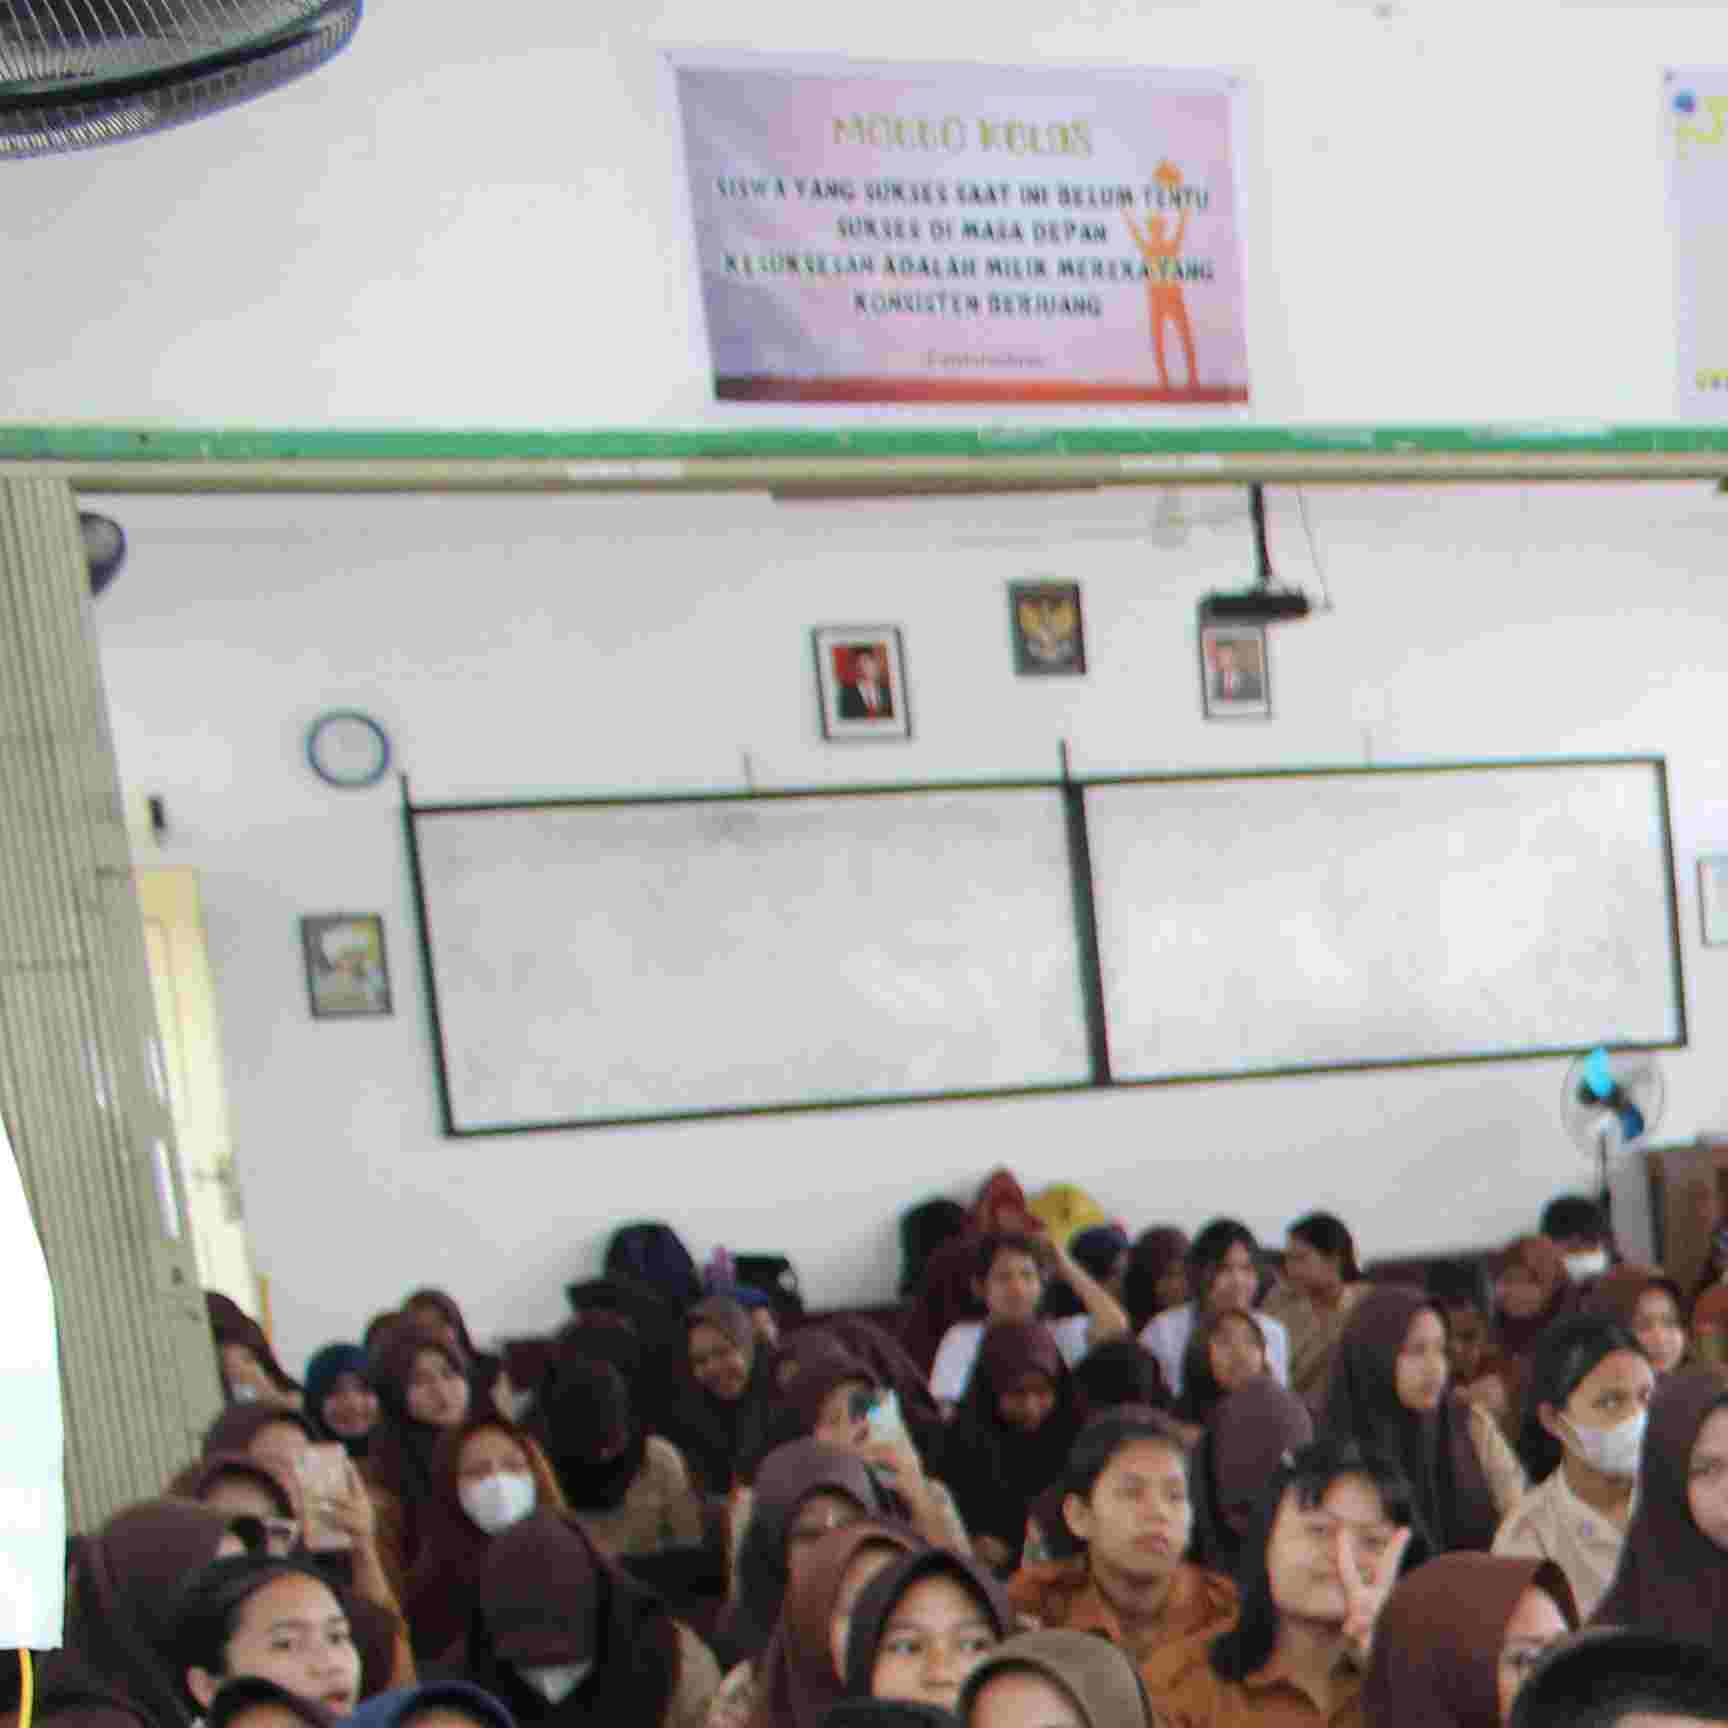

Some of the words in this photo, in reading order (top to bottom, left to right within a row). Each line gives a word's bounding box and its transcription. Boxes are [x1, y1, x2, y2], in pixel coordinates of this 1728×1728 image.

[717, 175, 785, 201] SISWA
[794, 177, 857, 203] YANG
[864, 179, 948, 204] SUKSES
[957, 181, 1010, 206] SAAT
[1020, 183, 1049, 207] INI
[1057, 184, 1136, 209] BELUM
[836, 215, 920, 241] SUKSES
[929, 217, 953, 241] DI
[1031, 220, 1108, 243] DEPAN
[884, 254, 977, 278] ADALAH
[852, 290, 979, 317] KONSISTEN
[990, 292, 1102, 319] BERJUANG
